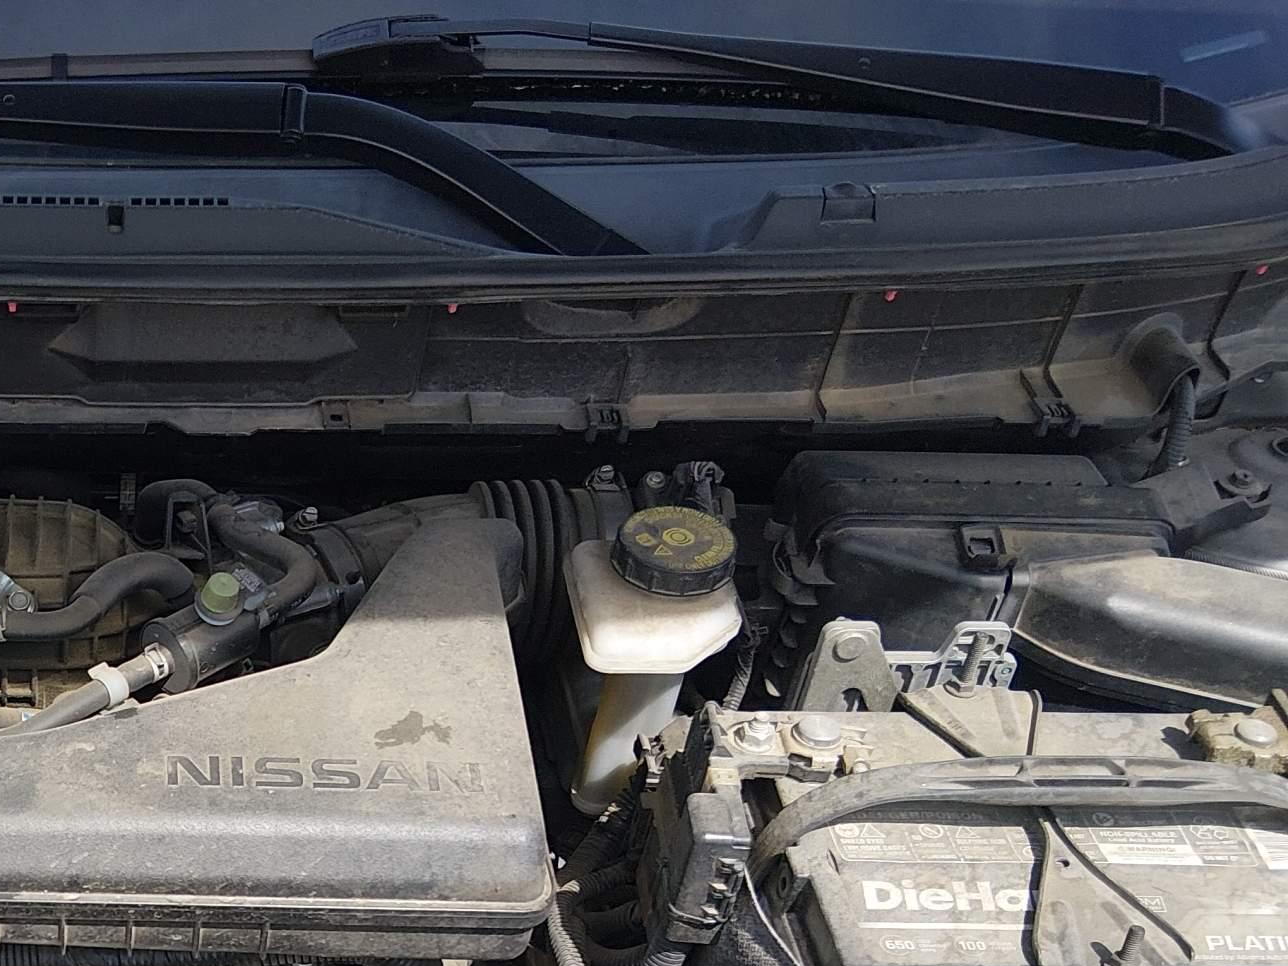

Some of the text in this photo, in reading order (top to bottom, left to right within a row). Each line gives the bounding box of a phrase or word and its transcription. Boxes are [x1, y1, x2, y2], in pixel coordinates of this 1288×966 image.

[167, 755, 484, 793] NISSAN
[862, 879, 1037, 912] DieHa
[885, 940, 915, 950] 650
[959, 940, 986, 951] 100
[1205, 935, 1288, 951] PLATI
